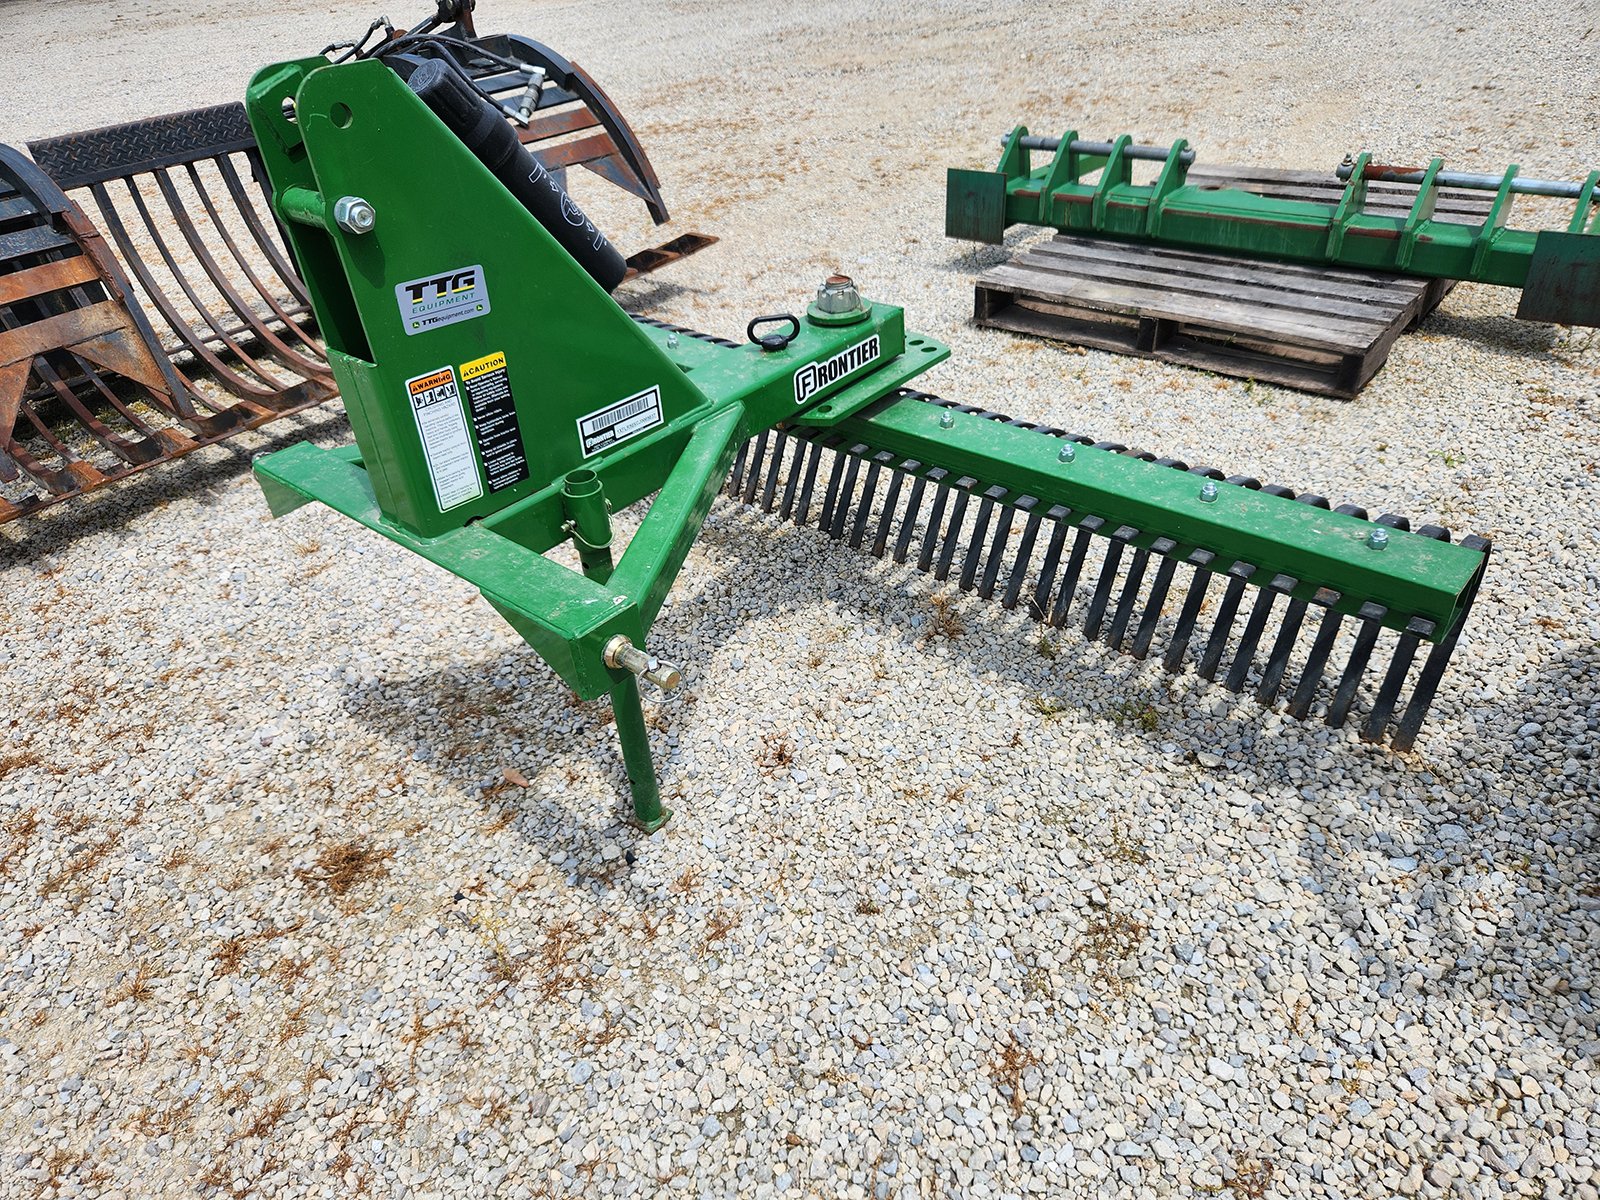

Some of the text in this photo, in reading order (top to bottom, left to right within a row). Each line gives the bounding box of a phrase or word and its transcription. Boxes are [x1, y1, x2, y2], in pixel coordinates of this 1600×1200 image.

[405, 270, 475, 305] TTG
[412, 292, 475, 314] EQUIPMENT
[421, 307, 474, 326] TTGequipment.com
[468, 357, 504, 375] CAUTION
[796, 337, 879, 402] FRONTIER
[417, 373, 451, 390] WARNING
